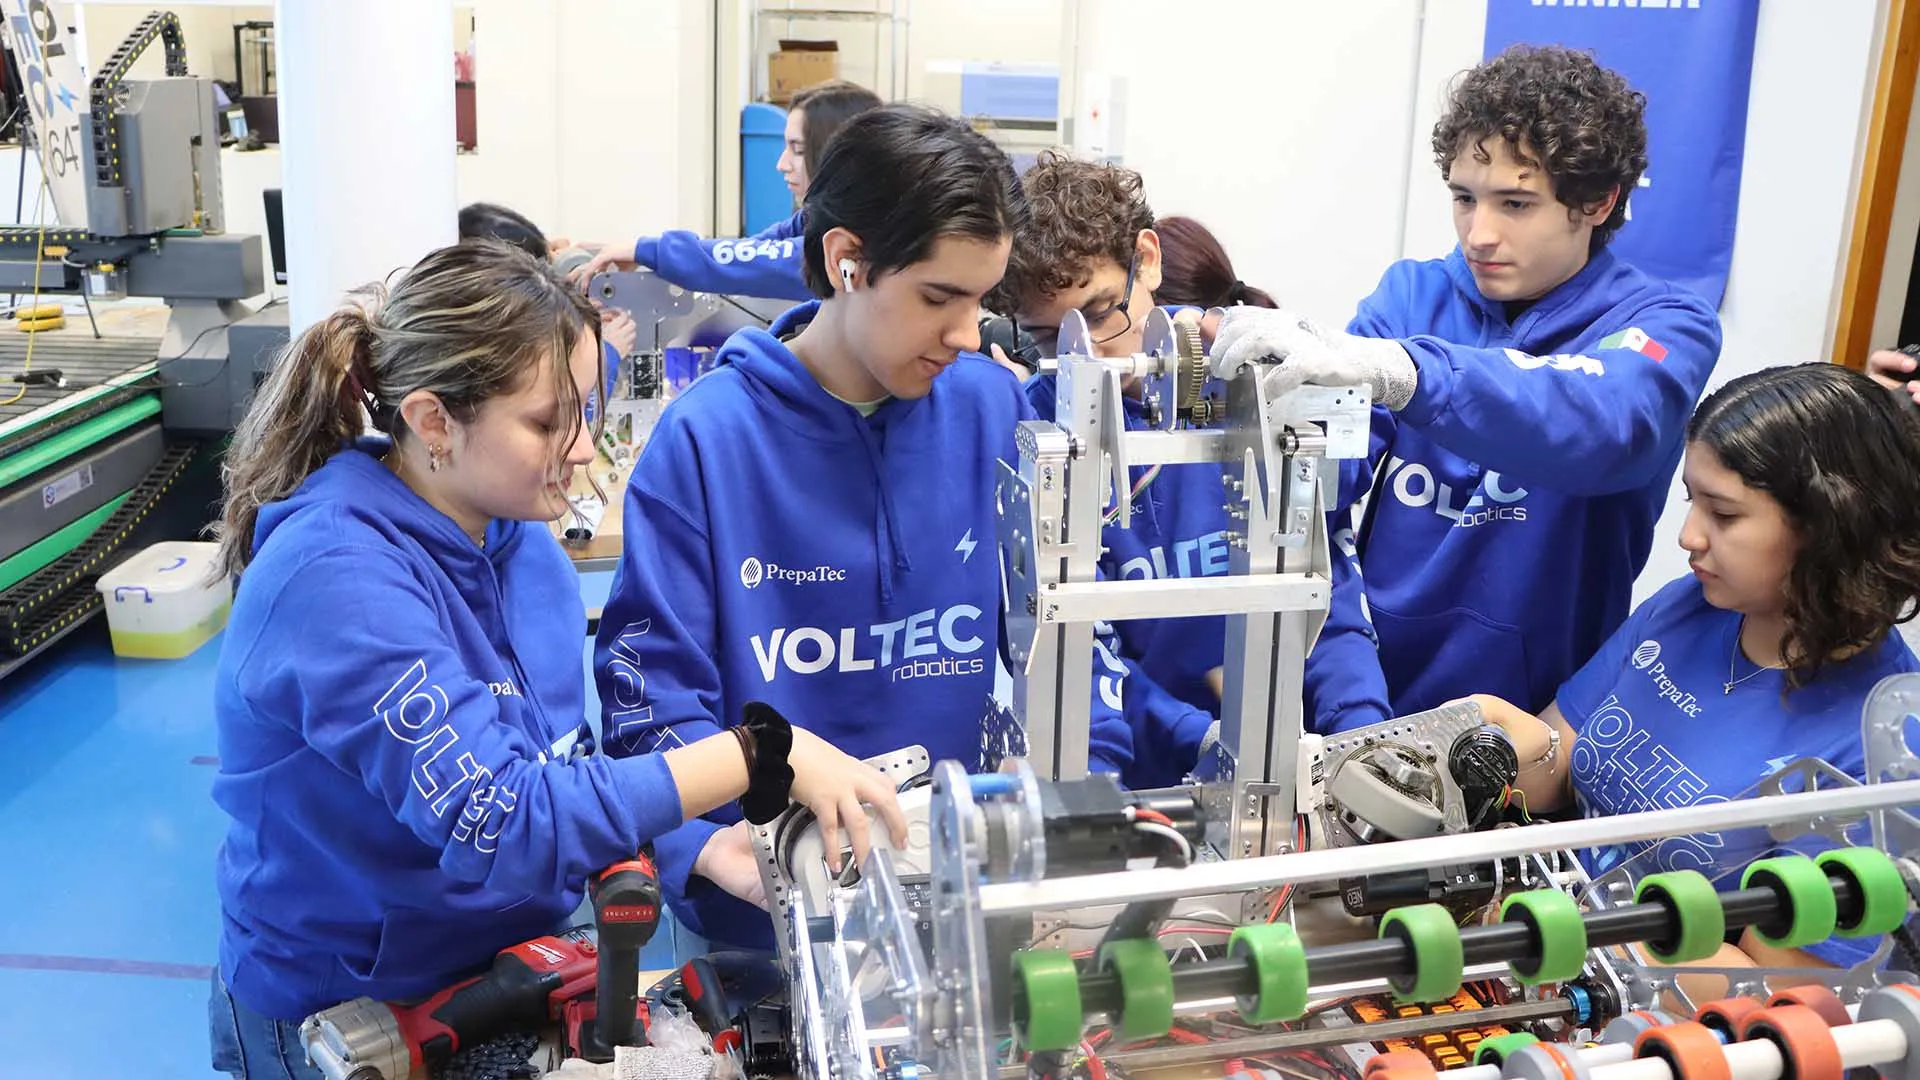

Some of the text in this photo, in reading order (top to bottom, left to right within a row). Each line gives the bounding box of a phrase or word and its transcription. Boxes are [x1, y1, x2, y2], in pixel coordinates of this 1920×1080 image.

[29, 0, 66, 77] OL
[712, 239, 795, 265] 6647
[766, 563, 847, 586] PrepaTec
[750, 604, 985, 683] VOLTEC
[892, 656, 984, 683] robotics
[1647, 661, 1703, 718] PrepaTec
